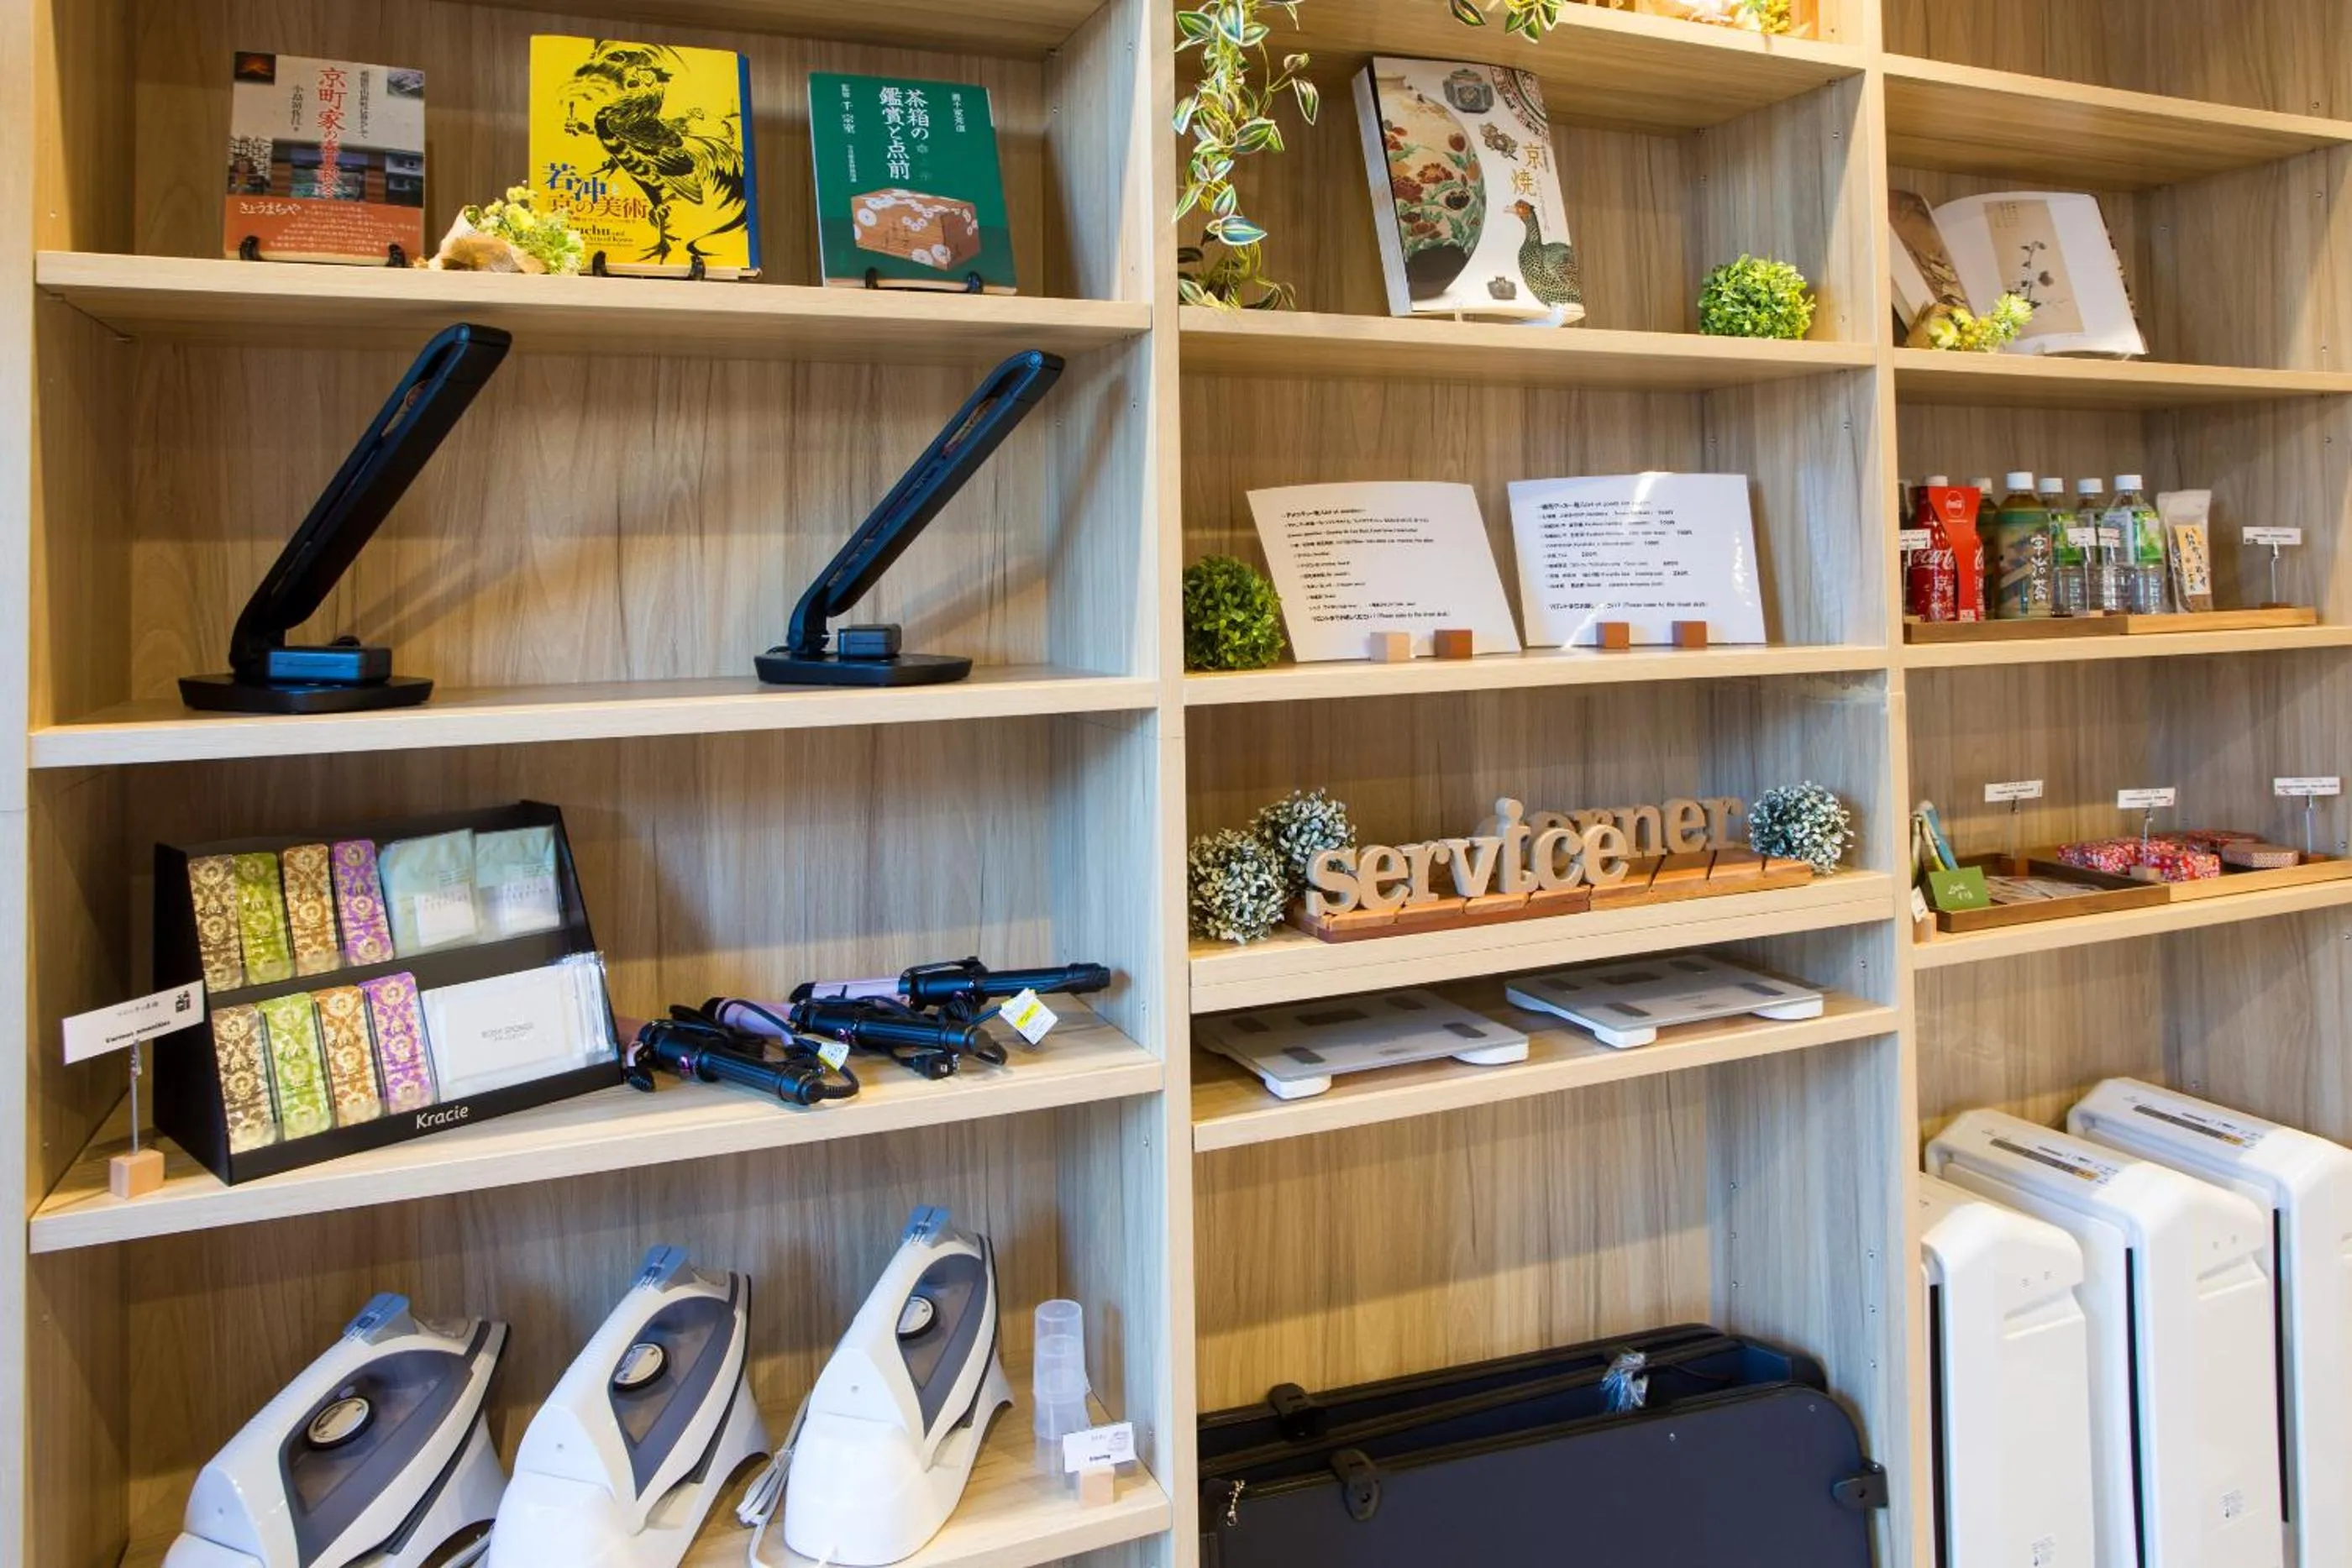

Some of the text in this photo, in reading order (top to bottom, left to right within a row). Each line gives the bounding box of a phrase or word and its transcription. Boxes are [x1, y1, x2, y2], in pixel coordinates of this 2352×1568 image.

[879, 87, 911, 180] 鑑賞と点前
[905, 89, 930, 139] 茶箱の
[1511, 141, 1544, 197] 京焼
[240, 202, 302, 215] きょうまちや
[416, 1105, 469, 1129] Kracie
